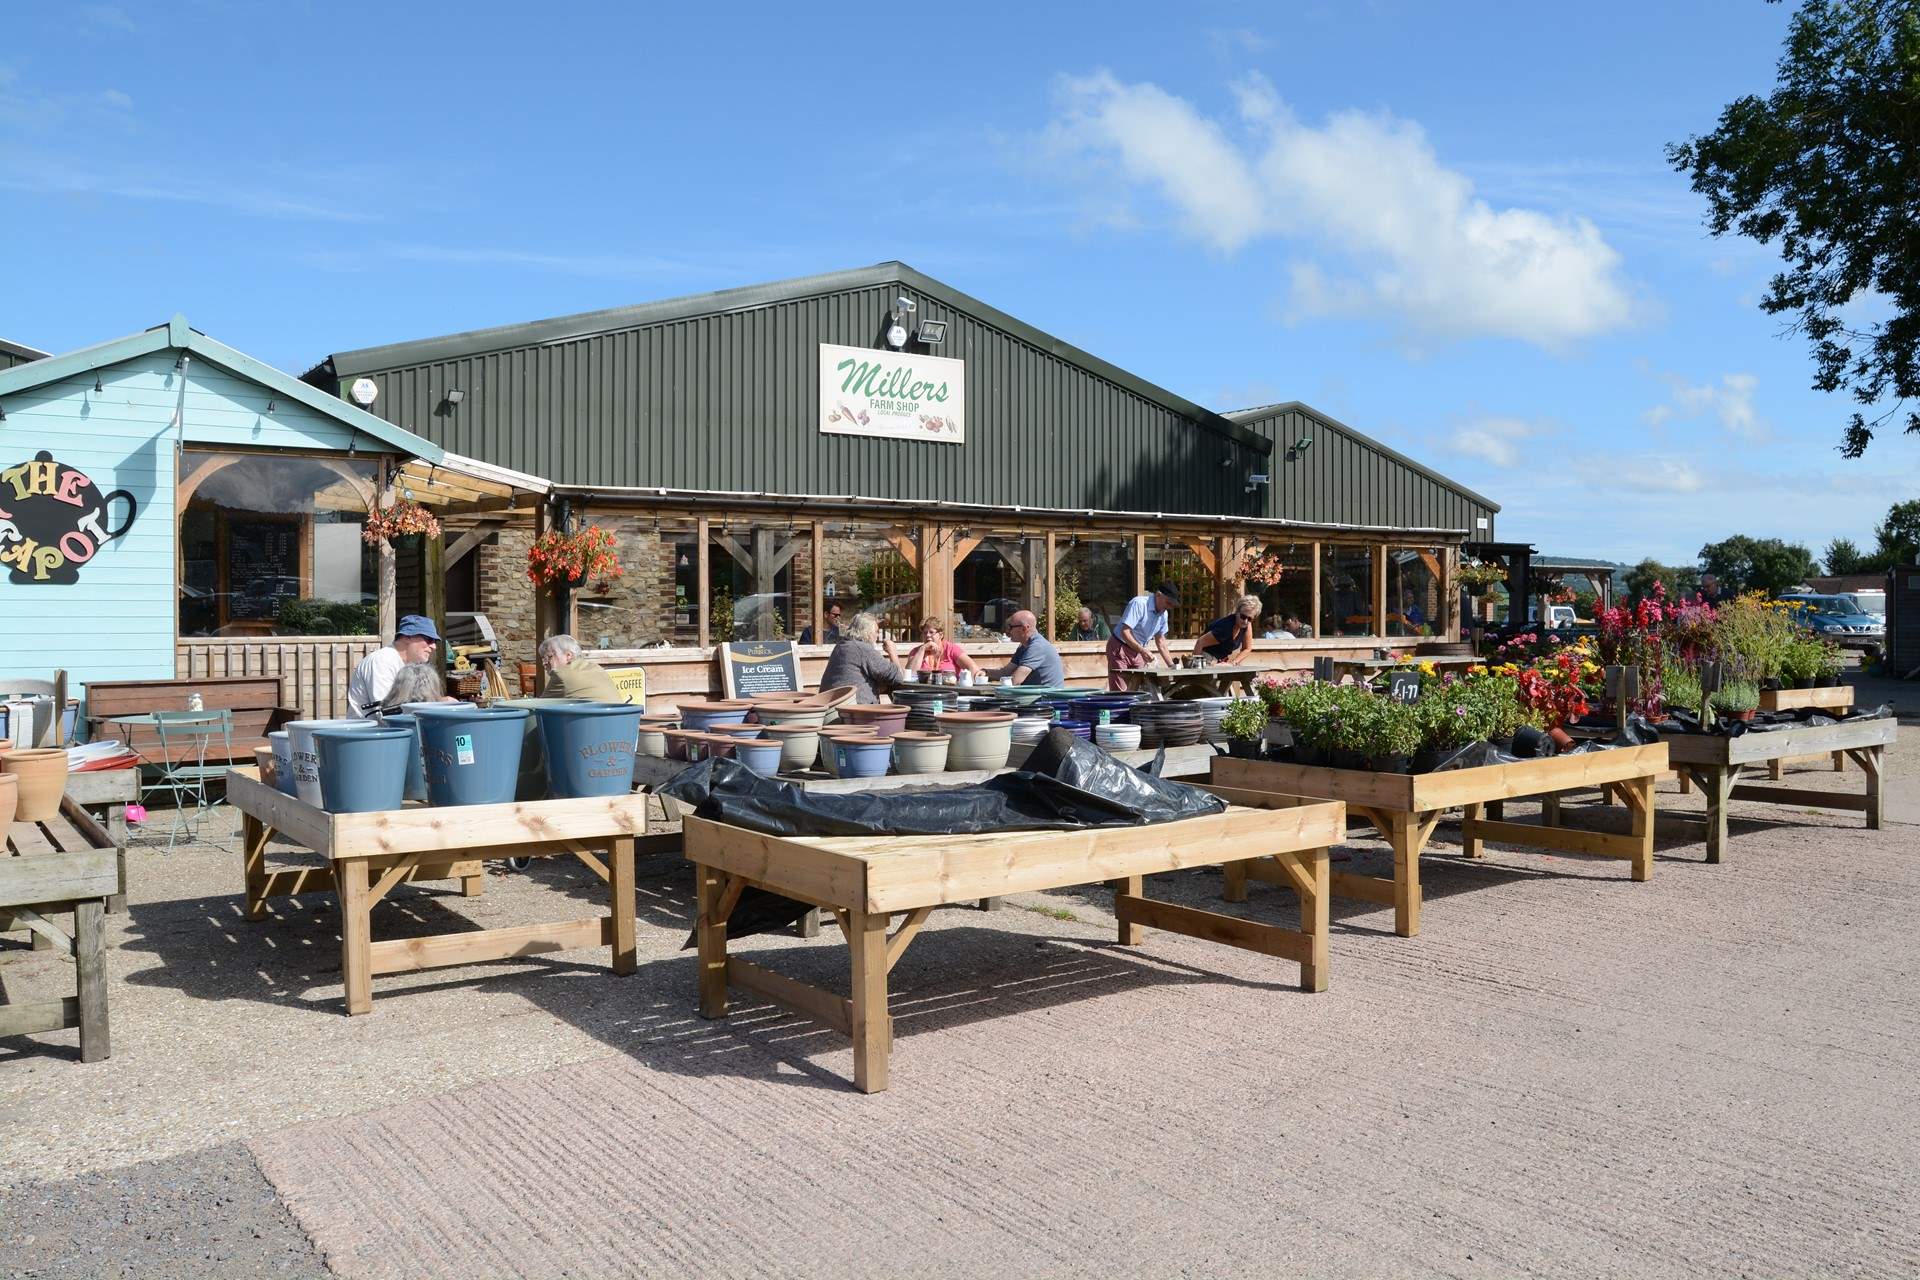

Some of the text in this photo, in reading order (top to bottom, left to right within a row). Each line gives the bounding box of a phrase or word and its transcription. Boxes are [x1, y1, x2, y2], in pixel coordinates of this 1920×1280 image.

[837, 358, 949, 402] Millers
[870, 399, 920, 413] FARM SHOP
[1, 461, 91, 507] THE
[741, 665, 784, 674] Ice Cream
[620, 679, 642, 690] COFFEE
[455, 736, 466, 747] 10
